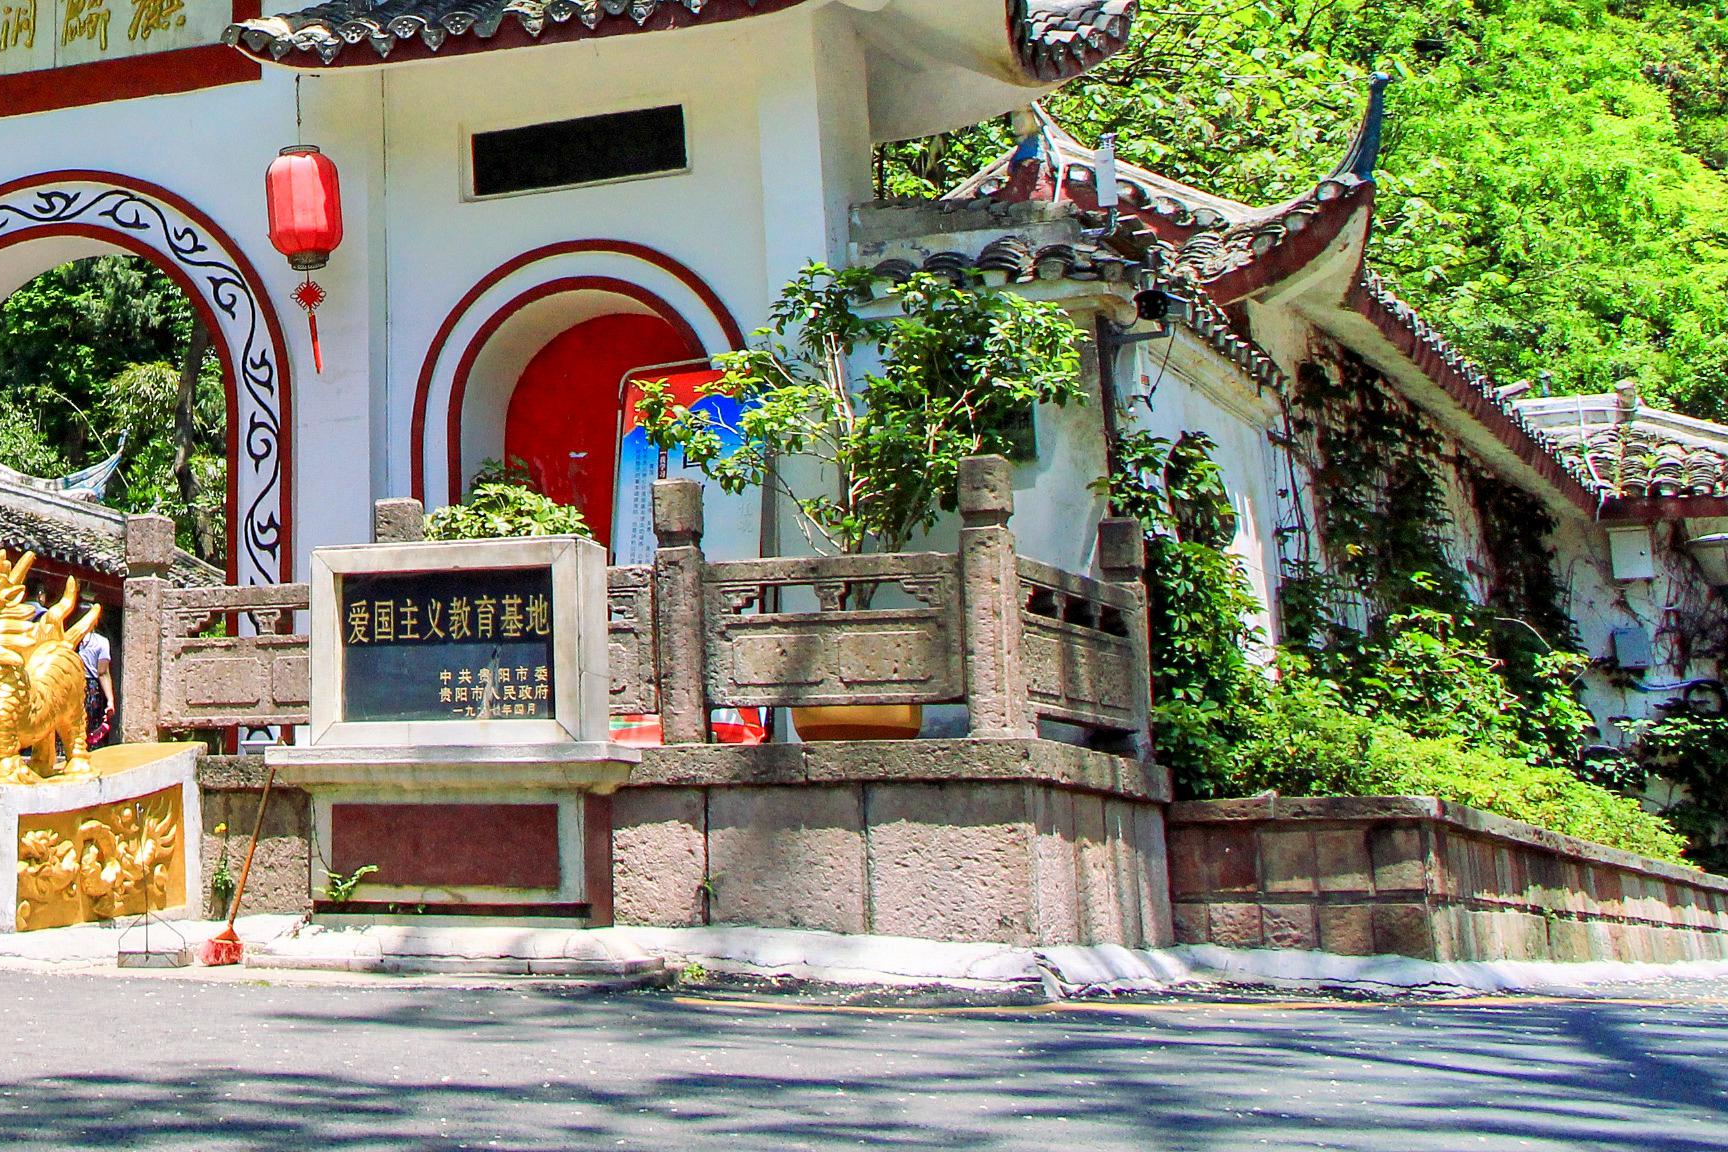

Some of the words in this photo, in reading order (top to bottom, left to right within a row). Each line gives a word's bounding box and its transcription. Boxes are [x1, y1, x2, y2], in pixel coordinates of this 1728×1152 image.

[347, 593, 551, 644] 爱国主义教育基地
[439, 665, 548, 685] 中共贵阳市委
[439, 683, 549, 702] 贵阳市人民政府
